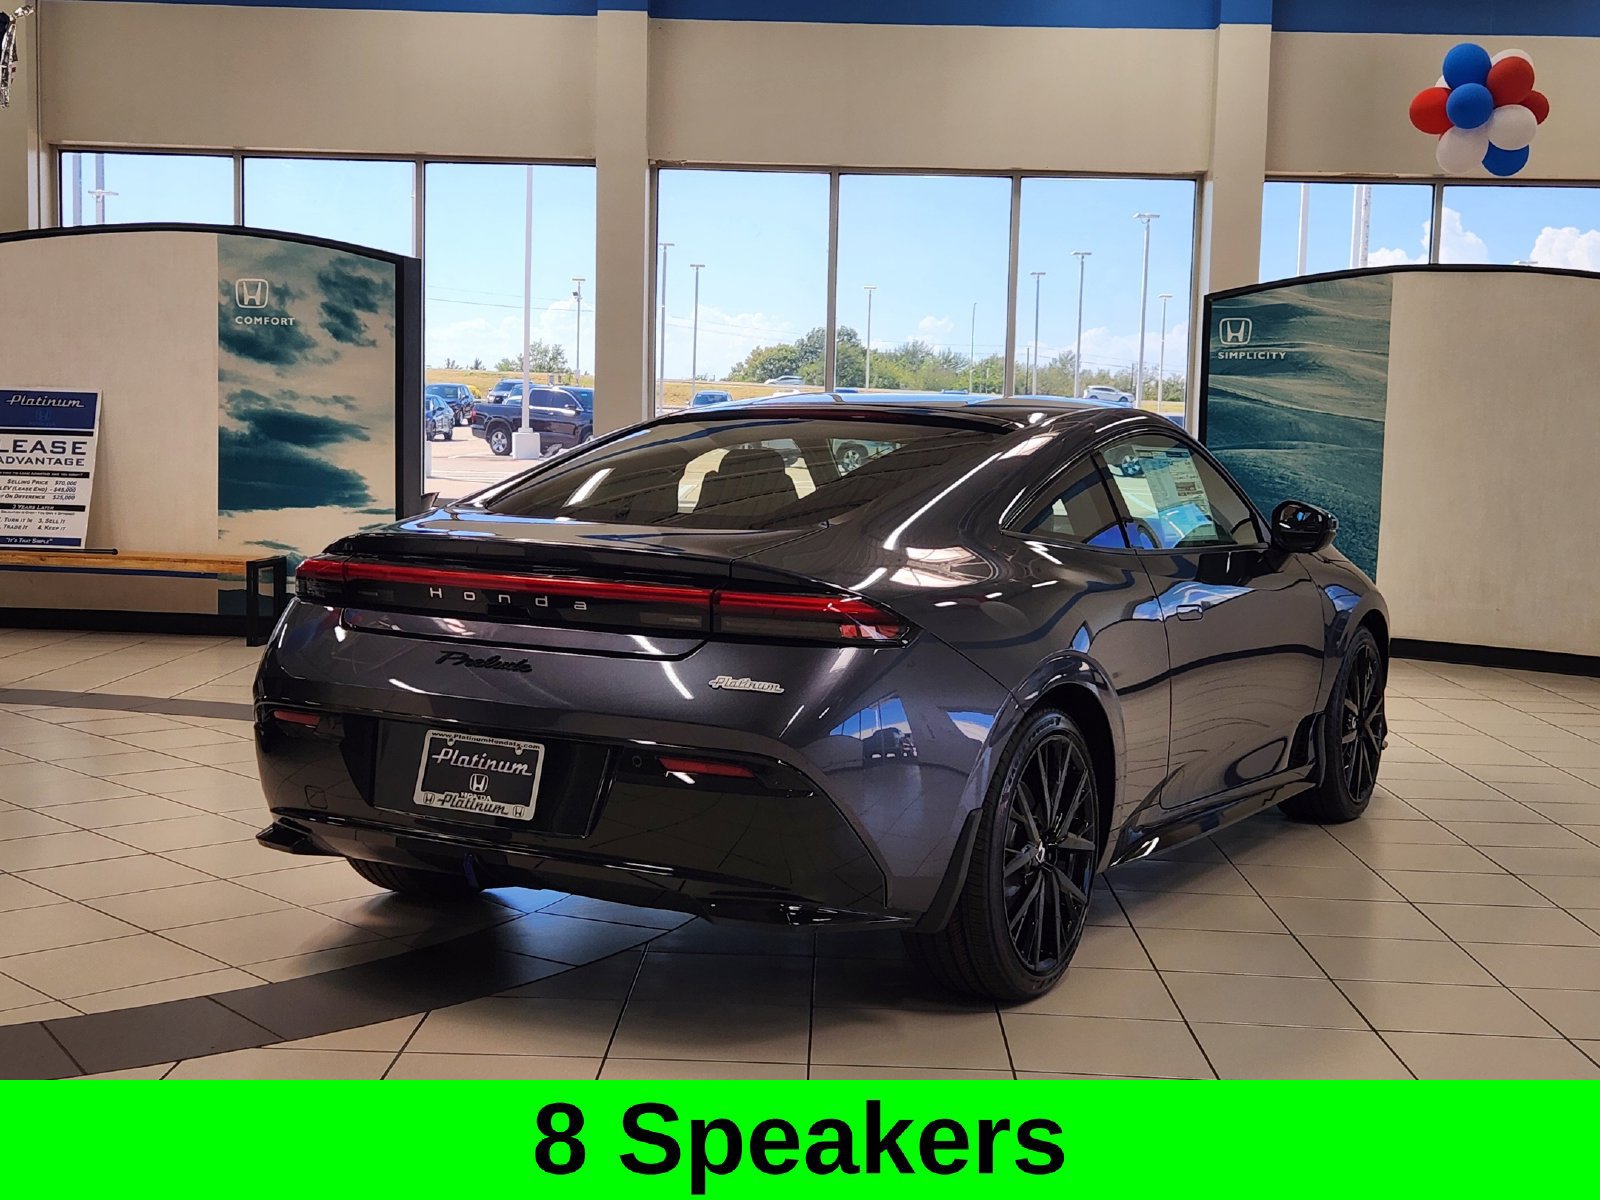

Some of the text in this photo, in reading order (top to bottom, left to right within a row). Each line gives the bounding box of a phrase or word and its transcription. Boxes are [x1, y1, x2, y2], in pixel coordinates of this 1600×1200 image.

[235, 316, 296, 326] COMFORT
[1217, 351, 1287, 360] SIMPLICITY
[6, 394, 85, 408] Platinum
[429, 587, 588, 611] Honda
[434, 650, 533, 673] Prelude
[708, 675, 785, 694] Platinum
[431, 748, 533, 776] Platinum
[437, 793, 509, 815] Platinum
[460, 792, 492, 802] HONDA
